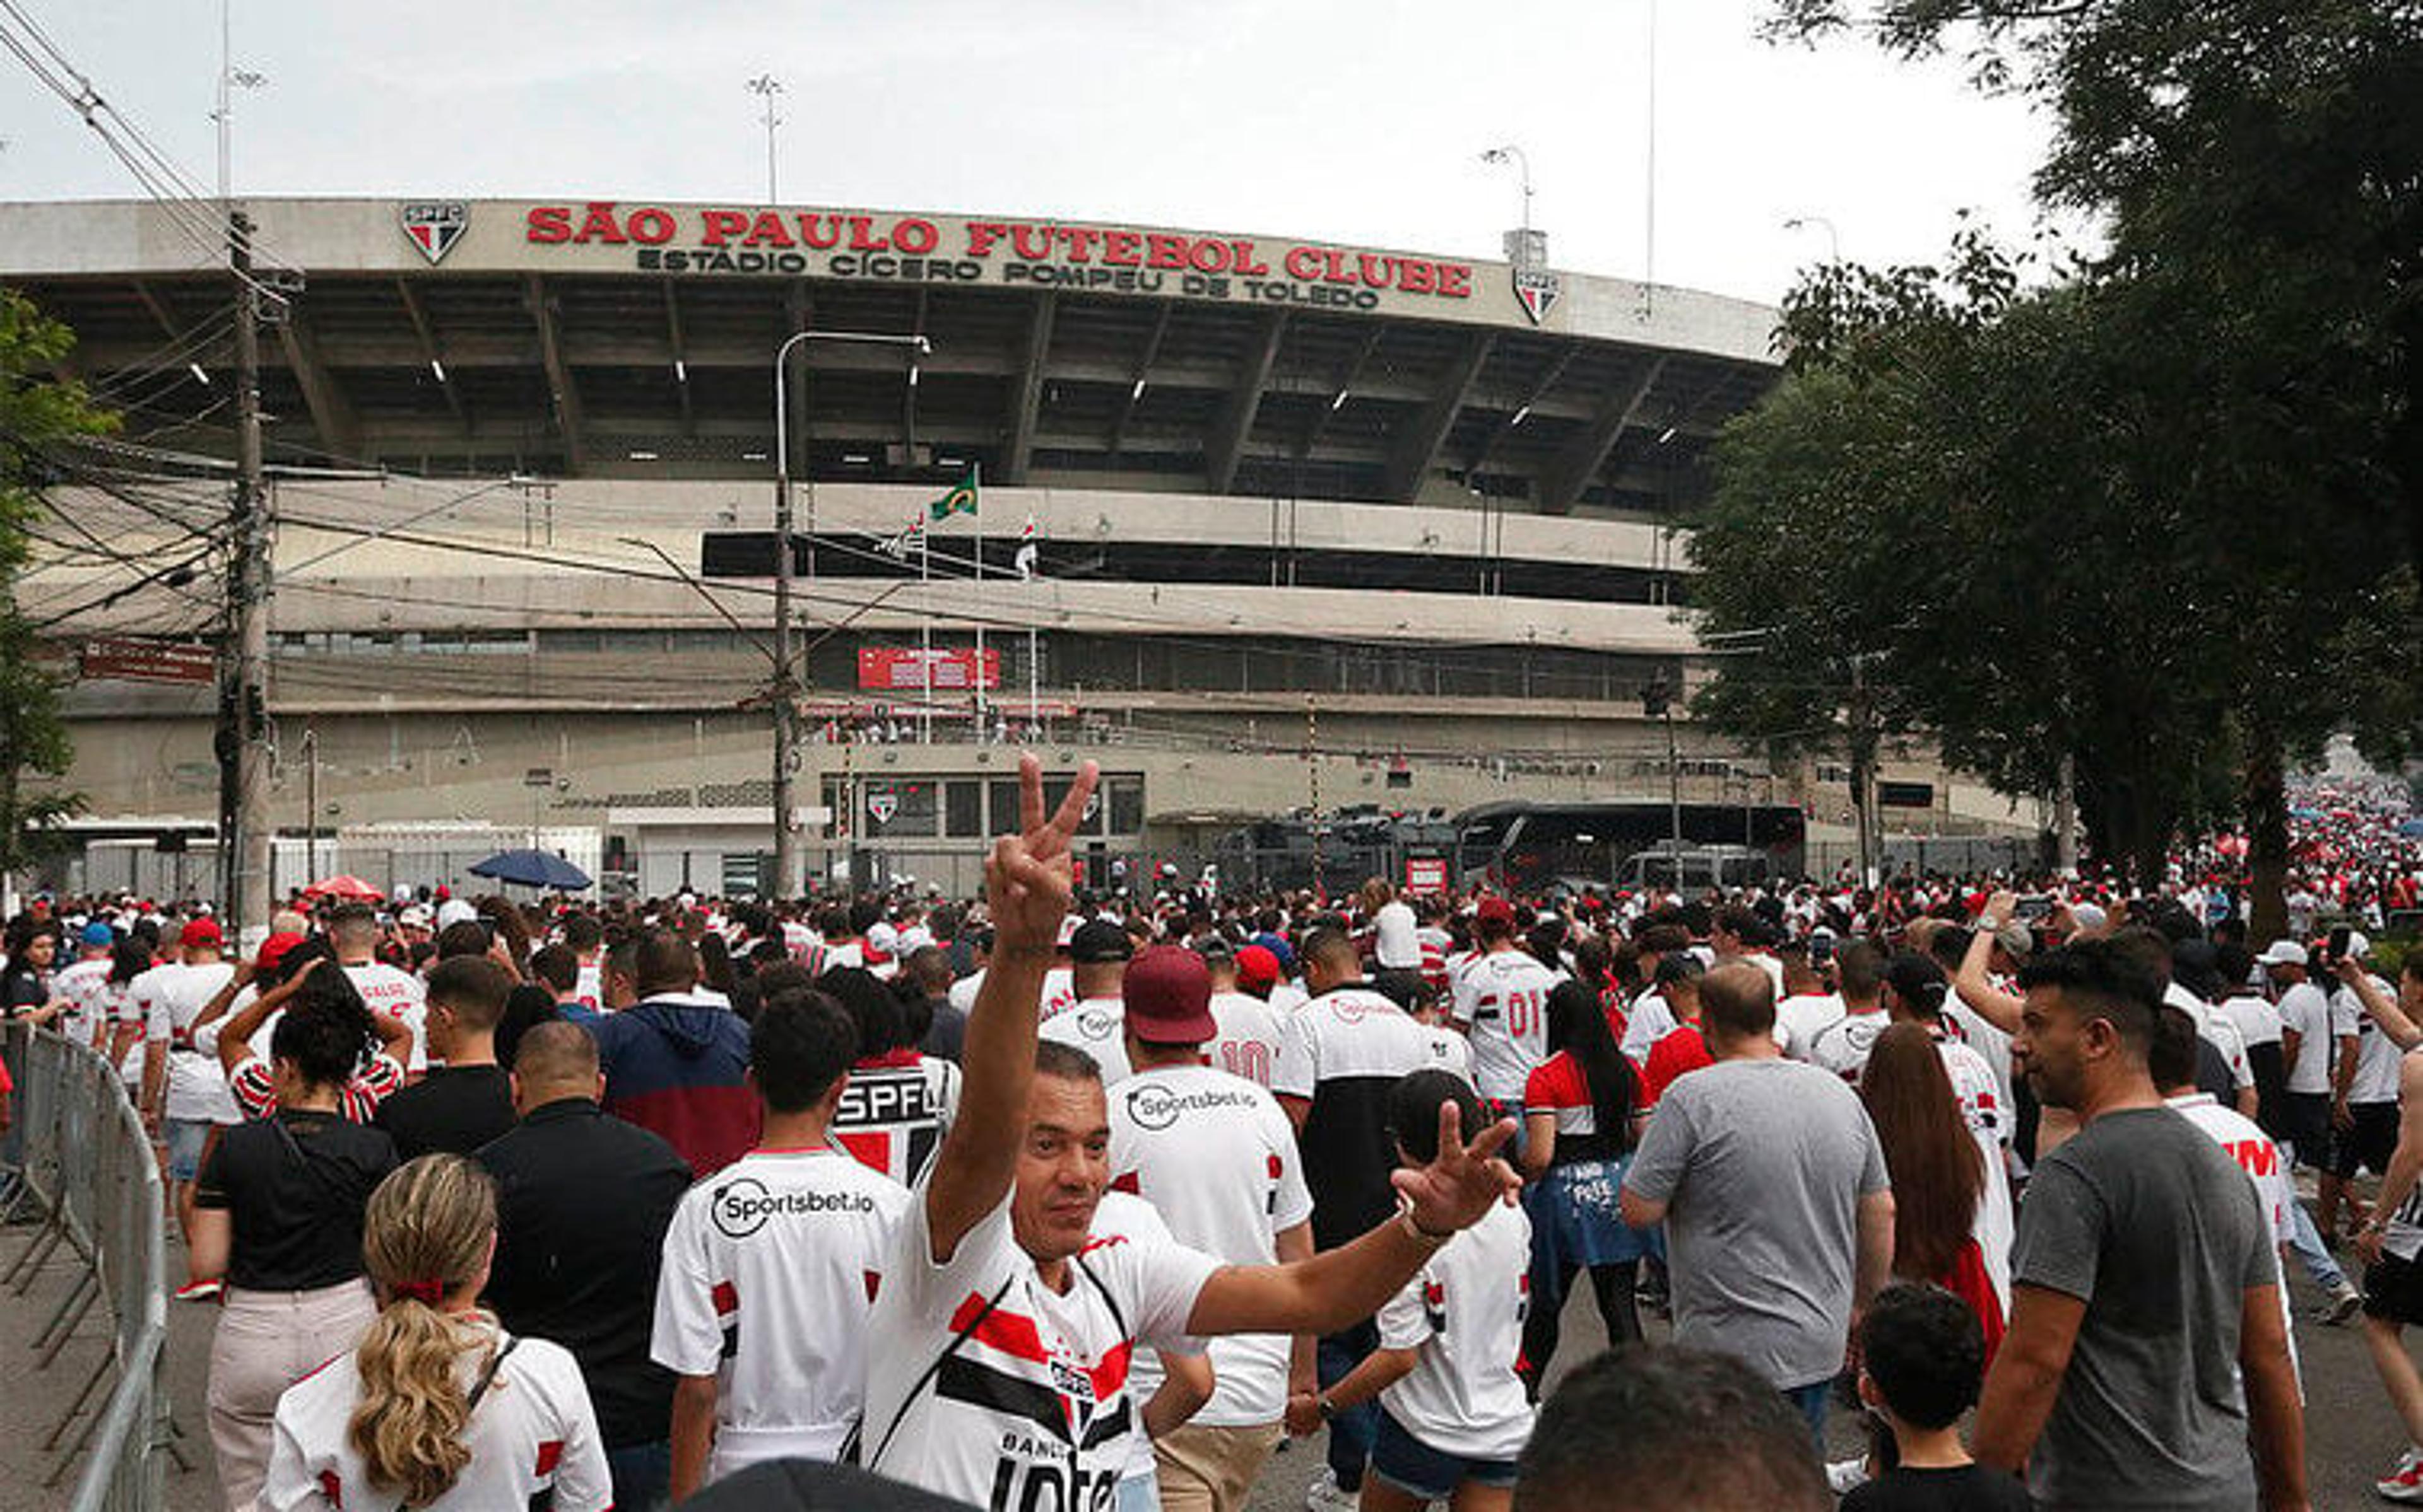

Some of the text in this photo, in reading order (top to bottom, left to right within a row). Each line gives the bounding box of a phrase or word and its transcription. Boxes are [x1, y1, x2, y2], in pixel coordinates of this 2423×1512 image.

[528, 202, 1471, 298] SÃO PAULO FUTEBOL CLUBE
[1003, 262, 1162, 291] POMPEU
[1182, 274, 1232, 298] DE
[1244, 279, 1379, 308] TOLEDO
[1221, 1041, 1270, 1089] 10
[726, 1191, 873, 1221] Sportsbet.io
